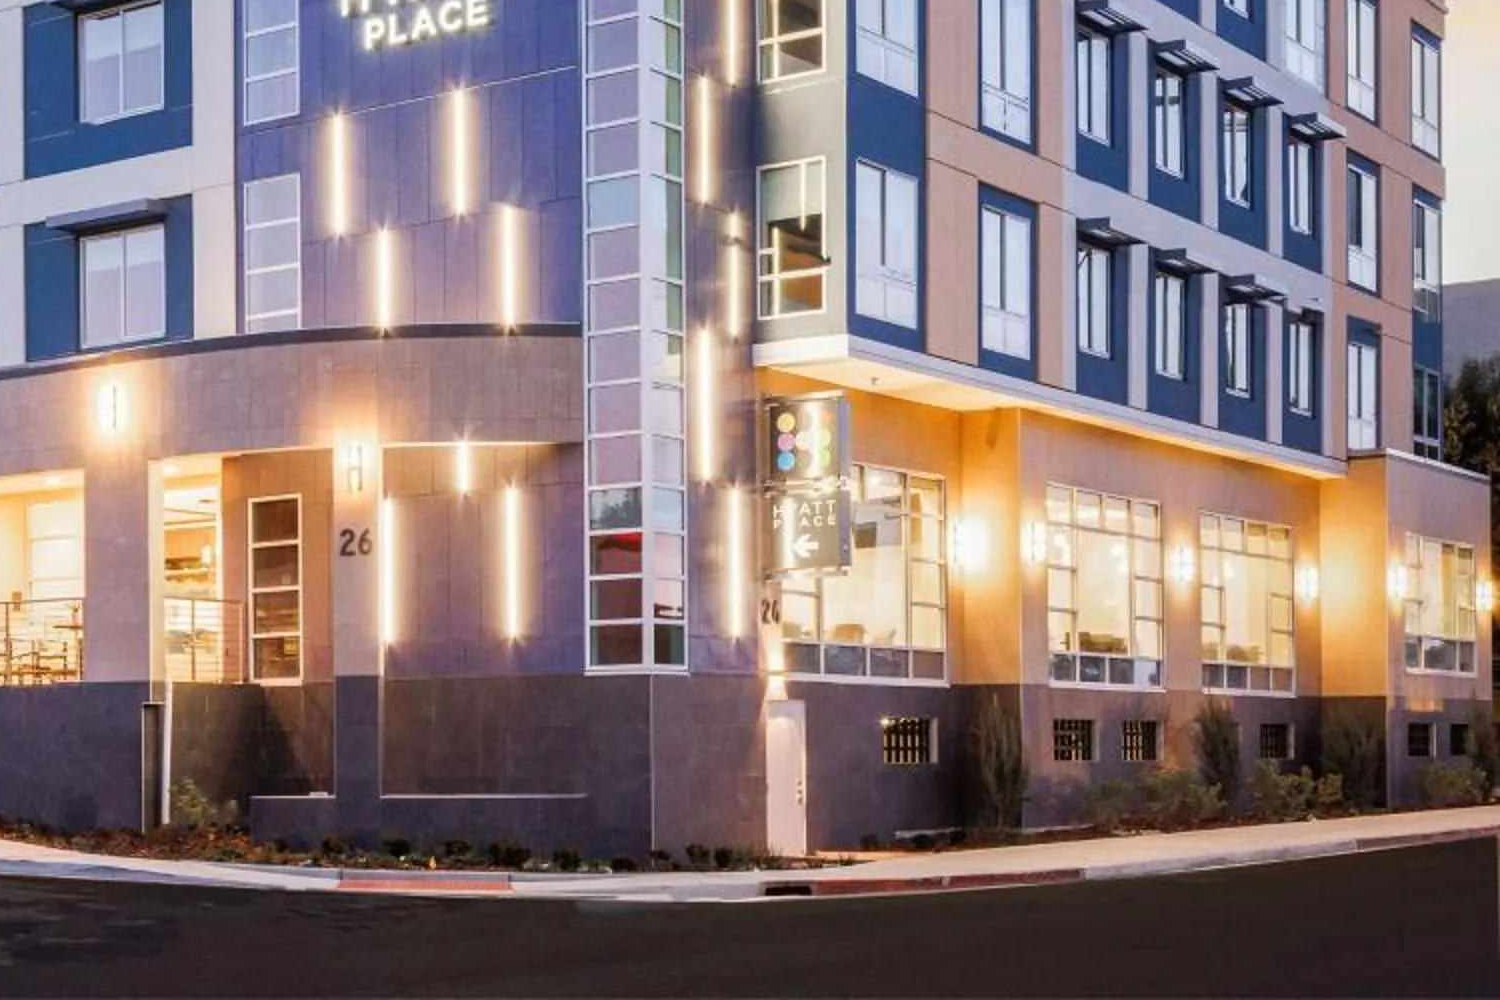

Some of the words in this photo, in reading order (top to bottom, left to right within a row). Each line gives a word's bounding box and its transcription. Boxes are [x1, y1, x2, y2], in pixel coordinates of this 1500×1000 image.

[773, 500, 836, 518] HATT
[773, 515, 836, 528] PACE
[339, 528, 373, 557] 26
